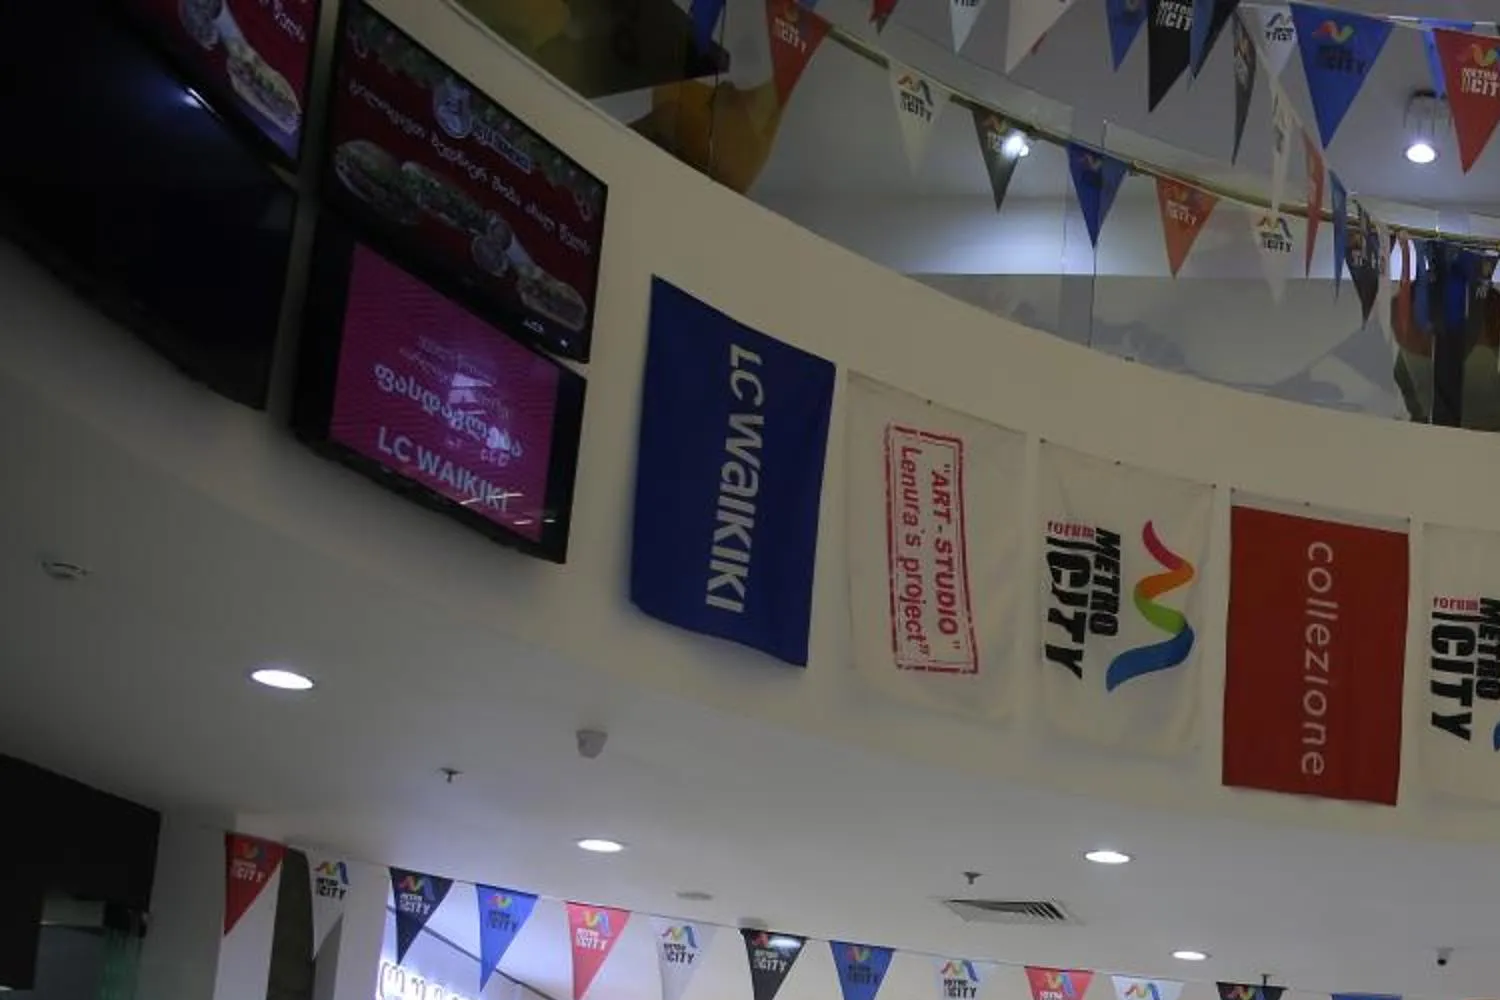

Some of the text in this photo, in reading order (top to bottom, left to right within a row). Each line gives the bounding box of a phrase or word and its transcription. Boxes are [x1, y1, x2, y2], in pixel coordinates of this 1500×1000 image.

[1163, 13, 1191, 30] CIT
[729, 344, 765, 407] LC
[377, 426, 508, 512] LC WAIKIKI
[1089, 526, 1121, 636] METRO
[1045, 551, 1091, 680] CITY
[1300, 541, 1339, 777] collezione
[1431, 624, 1476, 741] CITY
[322, 885, 347, 900] CITY
[405, 901, 430, 914] CITY
[667, 952, 695, 965] CITY
[759, 961, 786, 973] CITY
[951, 986, 976, 1000] CITY
